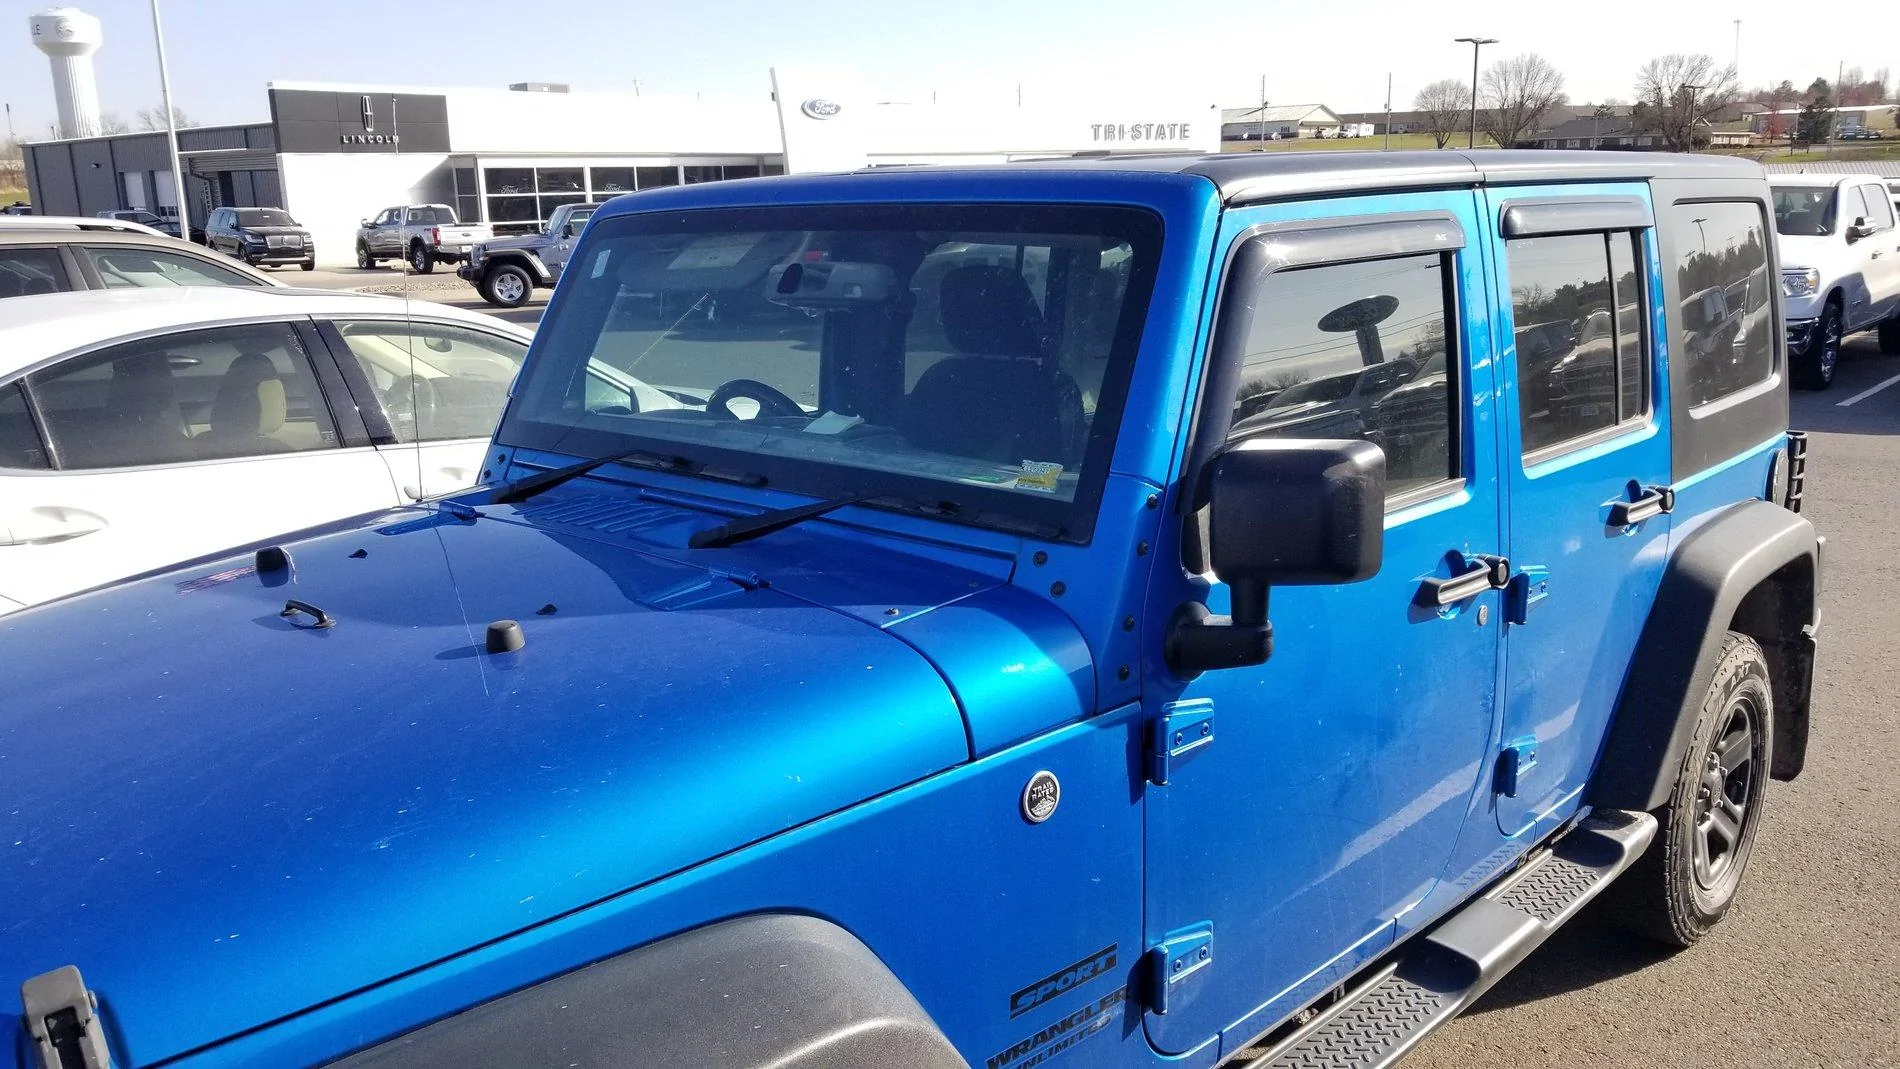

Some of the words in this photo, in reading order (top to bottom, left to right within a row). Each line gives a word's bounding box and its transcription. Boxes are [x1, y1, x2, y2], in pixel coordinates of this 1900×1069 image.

[814, 101, 836, 114] Ford
[1091, 123, 1190, 141] TRI-STATE
[342, 135, 400, 144] LINCOLN
[1032, 787, 1054, 800] RATED
[1033, 782, 1053, 793] TRAIL
[1011, 950, 1117, 1014] SPORT
[986, 986, 1128, 1069] WRANGLER
